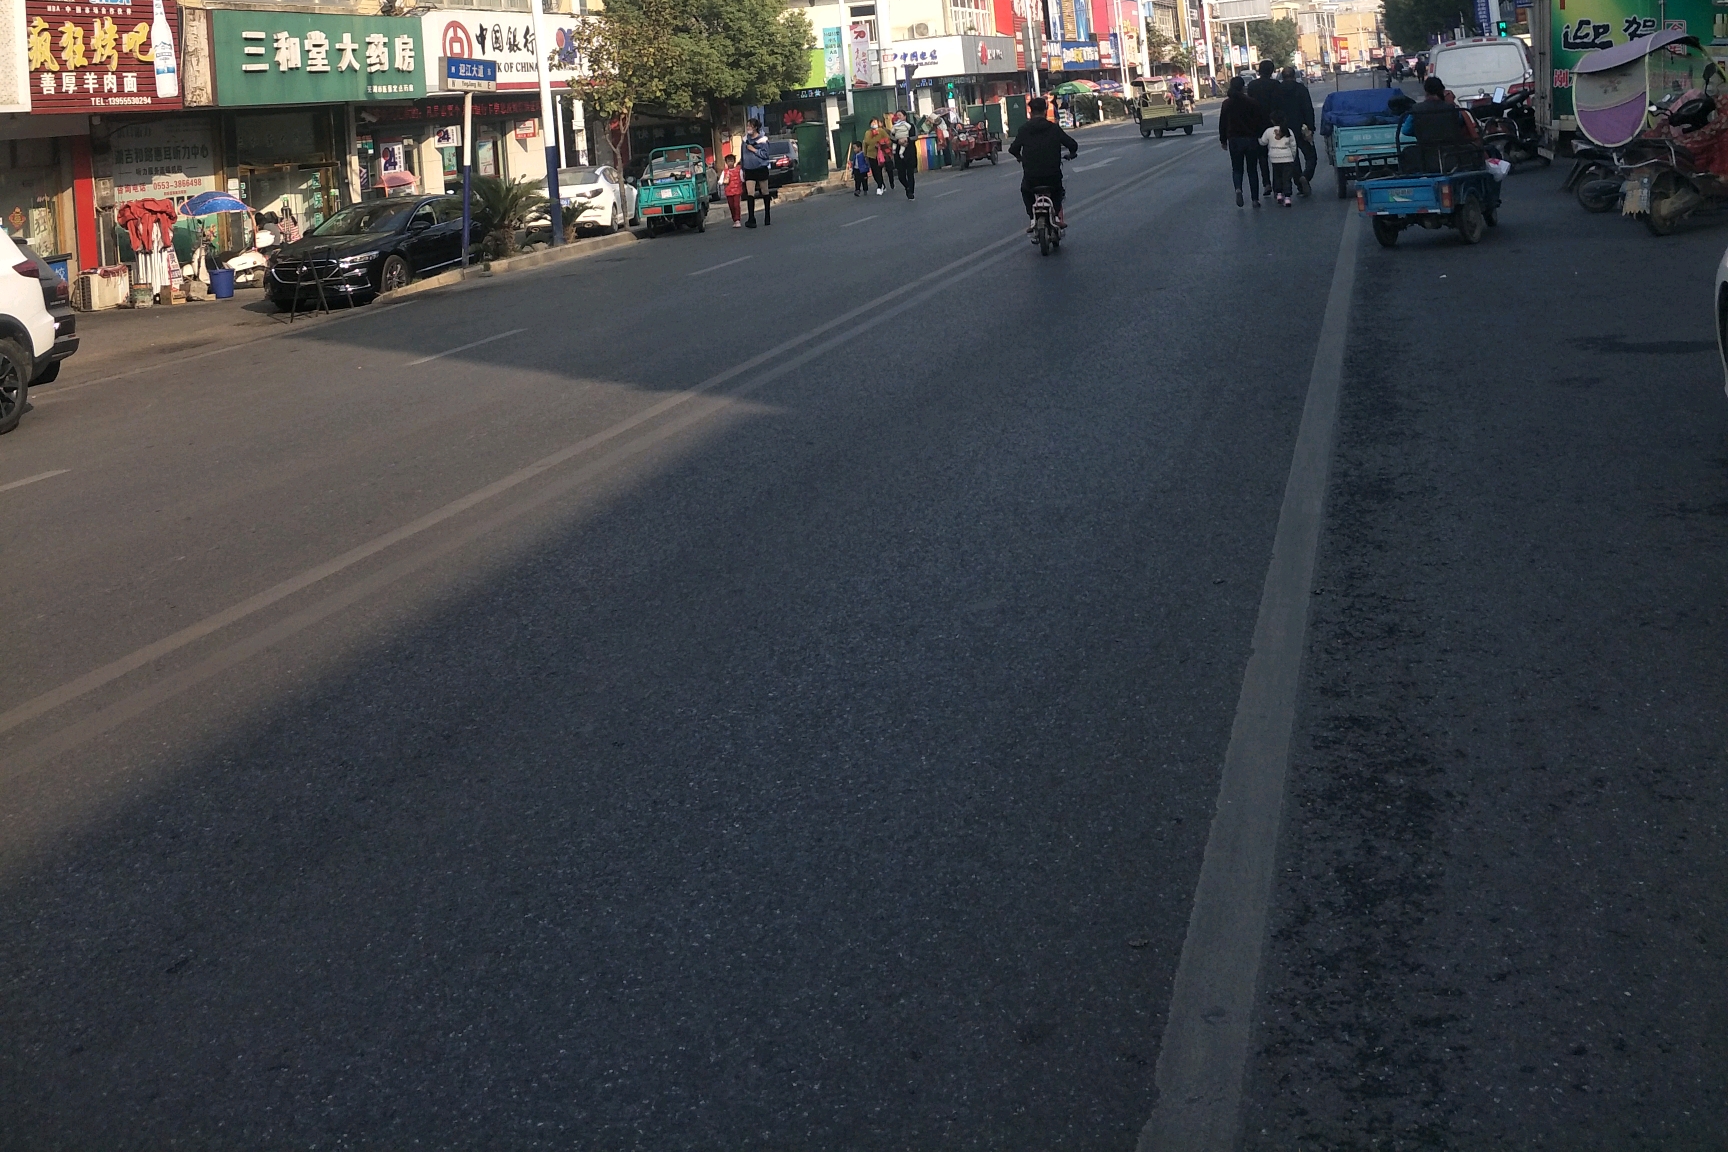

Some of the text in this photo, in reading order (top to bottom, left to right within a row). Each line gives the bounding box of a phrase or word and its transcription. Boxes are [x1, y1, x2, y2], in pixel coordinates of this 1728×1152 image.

[27, 16, 155, 72] 疯狂烤吧
[475, 23, 536, 55] 中国银行
[241, 31, 415, 73] 三和堂大药房
[900, 49, 938, 64] 中国电信
[459, 63, 484, 77] 迎江大道
[504, 62, 514, 73] OF
[515, 62, 538, 73] CHINA
[40, 72, 138, 95] 善厚羊肉面
[436, 129, 451, 142] 24
[382, 147, 398, 172] 24
